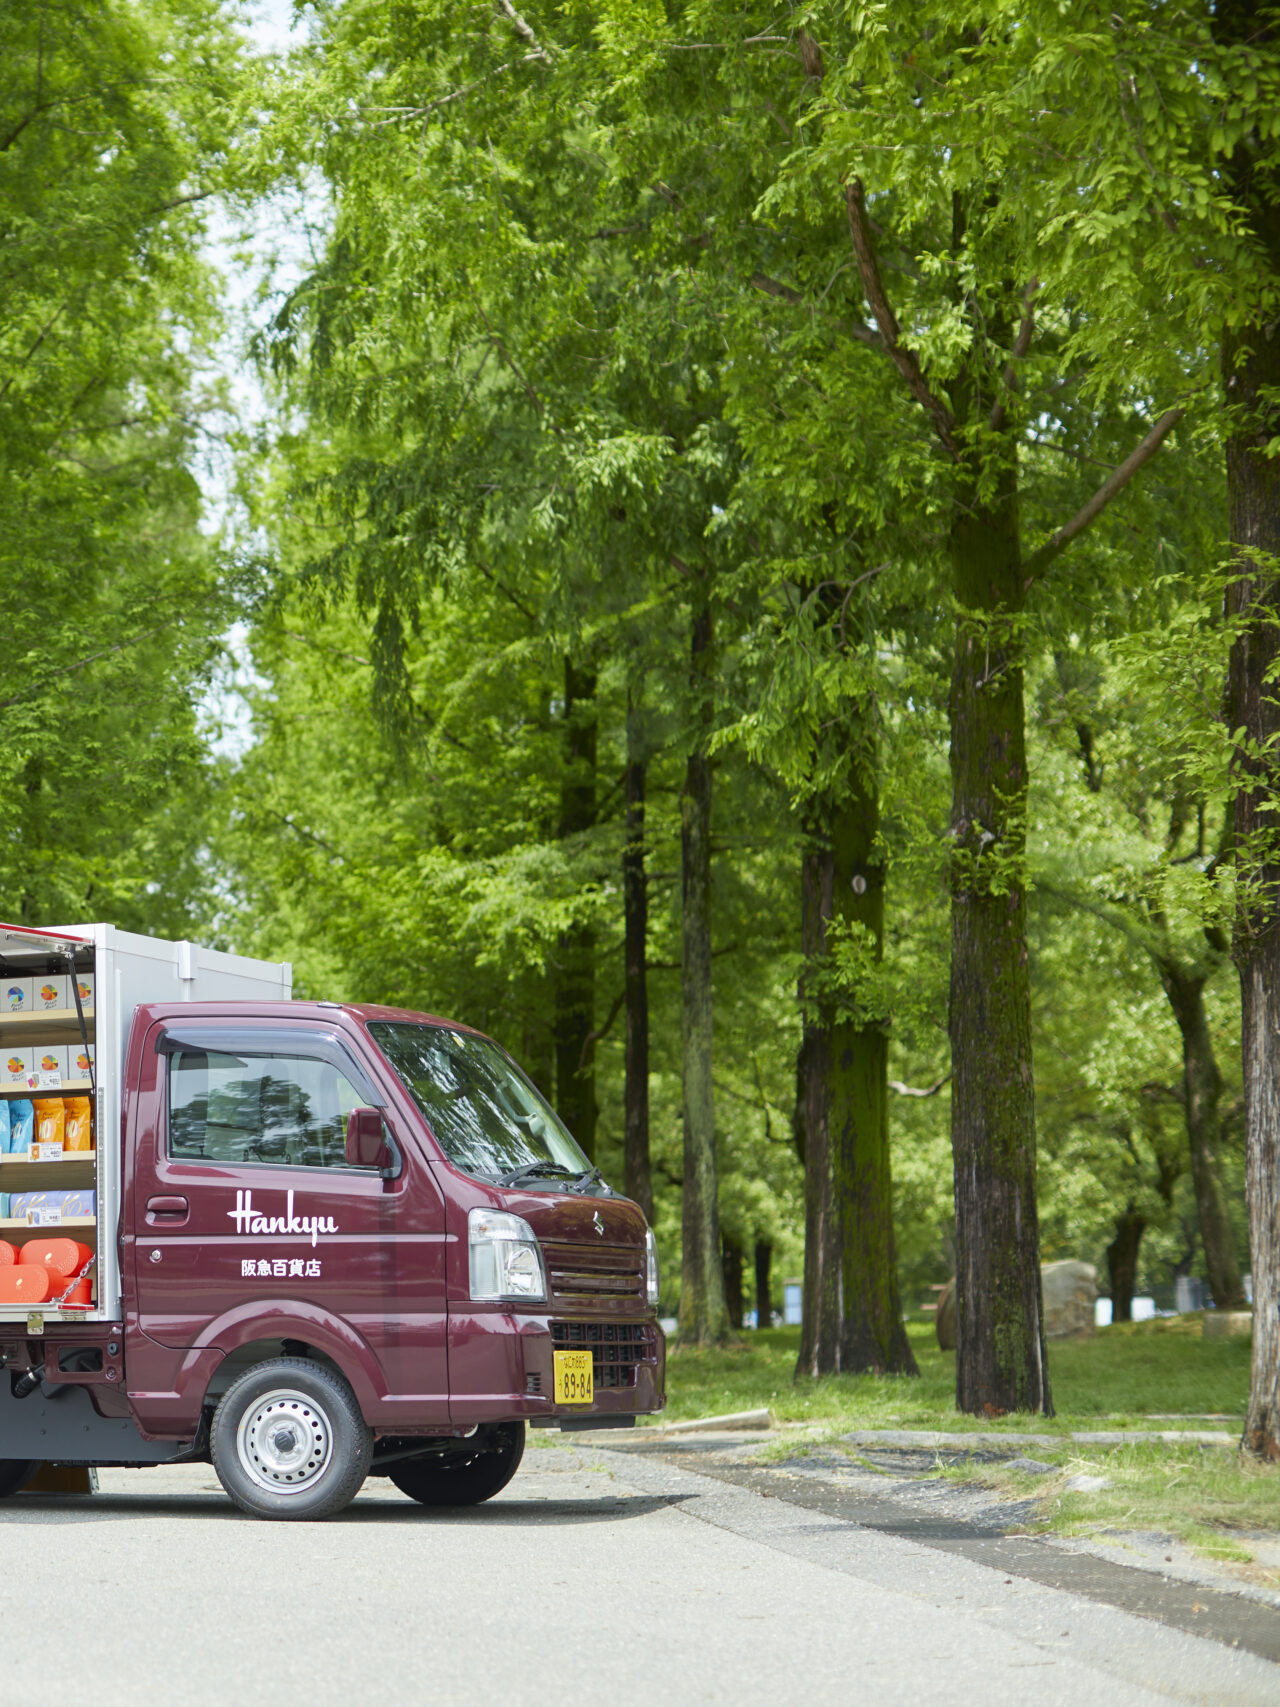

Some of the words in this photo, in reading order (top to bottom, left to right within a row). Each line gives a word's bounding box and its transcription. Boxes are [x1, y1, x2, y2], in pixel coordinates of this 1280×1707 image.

[226, 1189, 339, 1248] Hankyu
[241, 1258, 322, 1277] 阪急百貨店
[564, 1373, 591, 1399] 89-84
